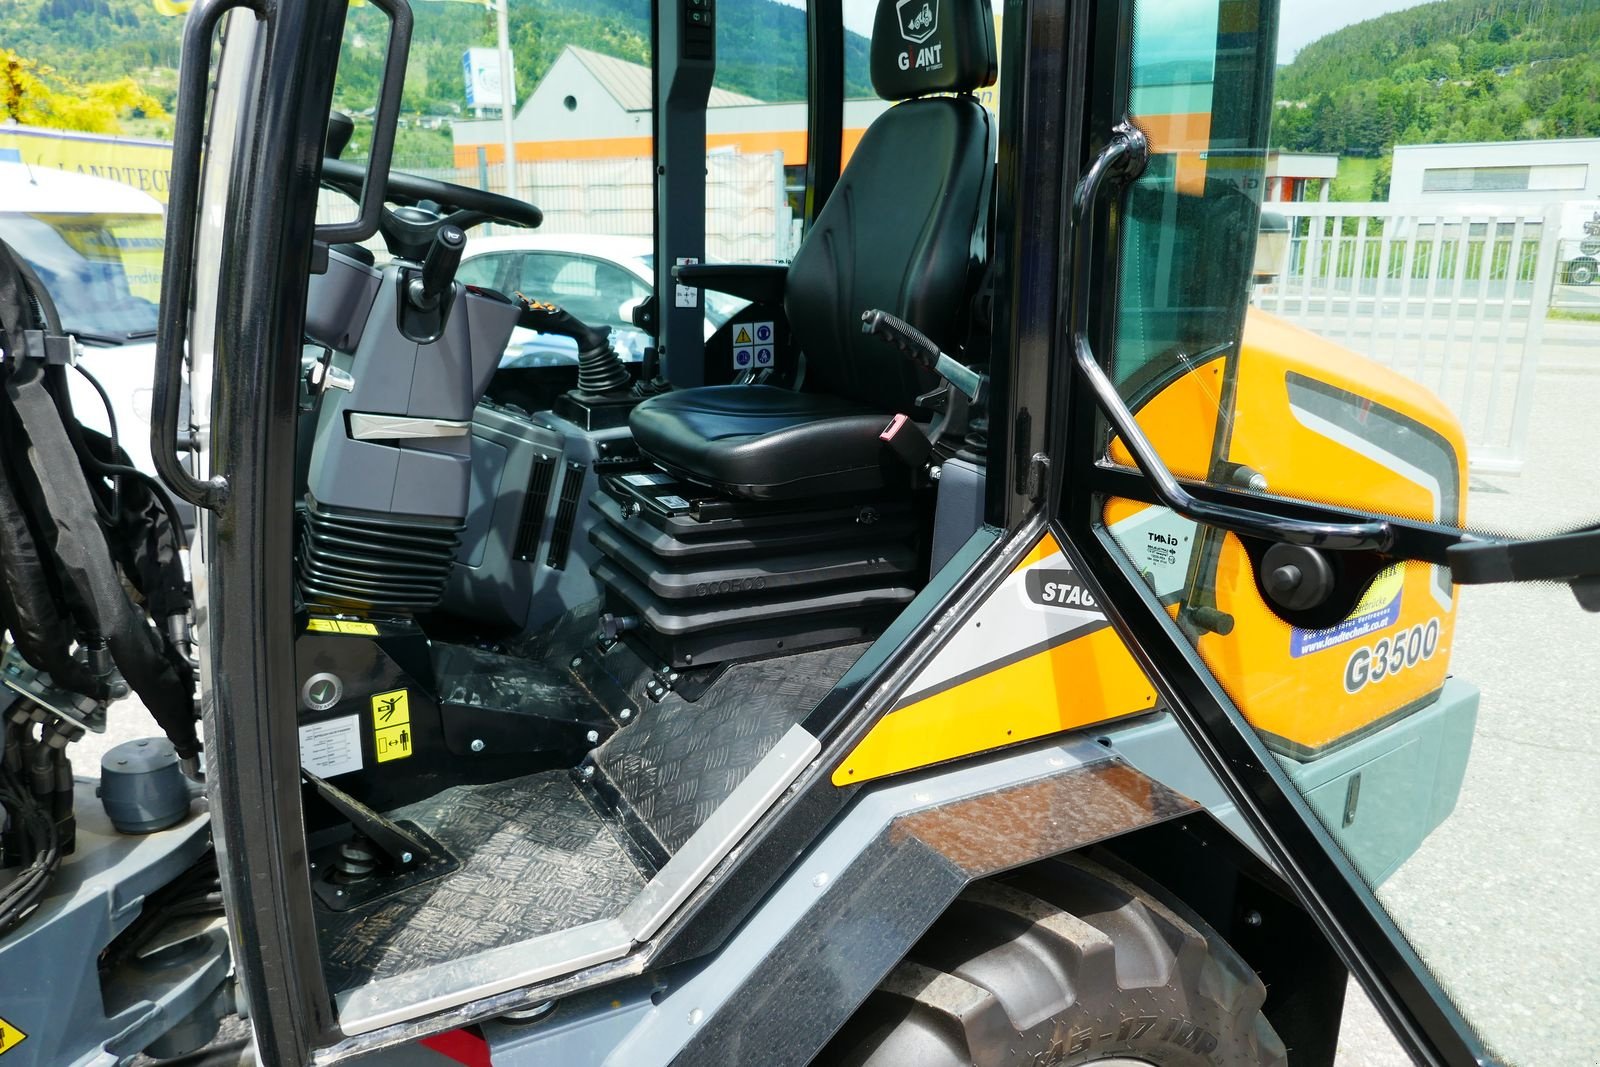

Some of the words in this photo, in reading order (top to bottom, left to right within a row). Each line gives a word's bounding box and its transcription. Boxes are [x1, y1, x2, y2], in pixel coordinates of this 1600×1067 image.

[1042, 582, 1098, 608] STAG
[1301, 617, 1389, 654] www.landtechnik.co.at
[1344, 617, 1439, 693] G3500
